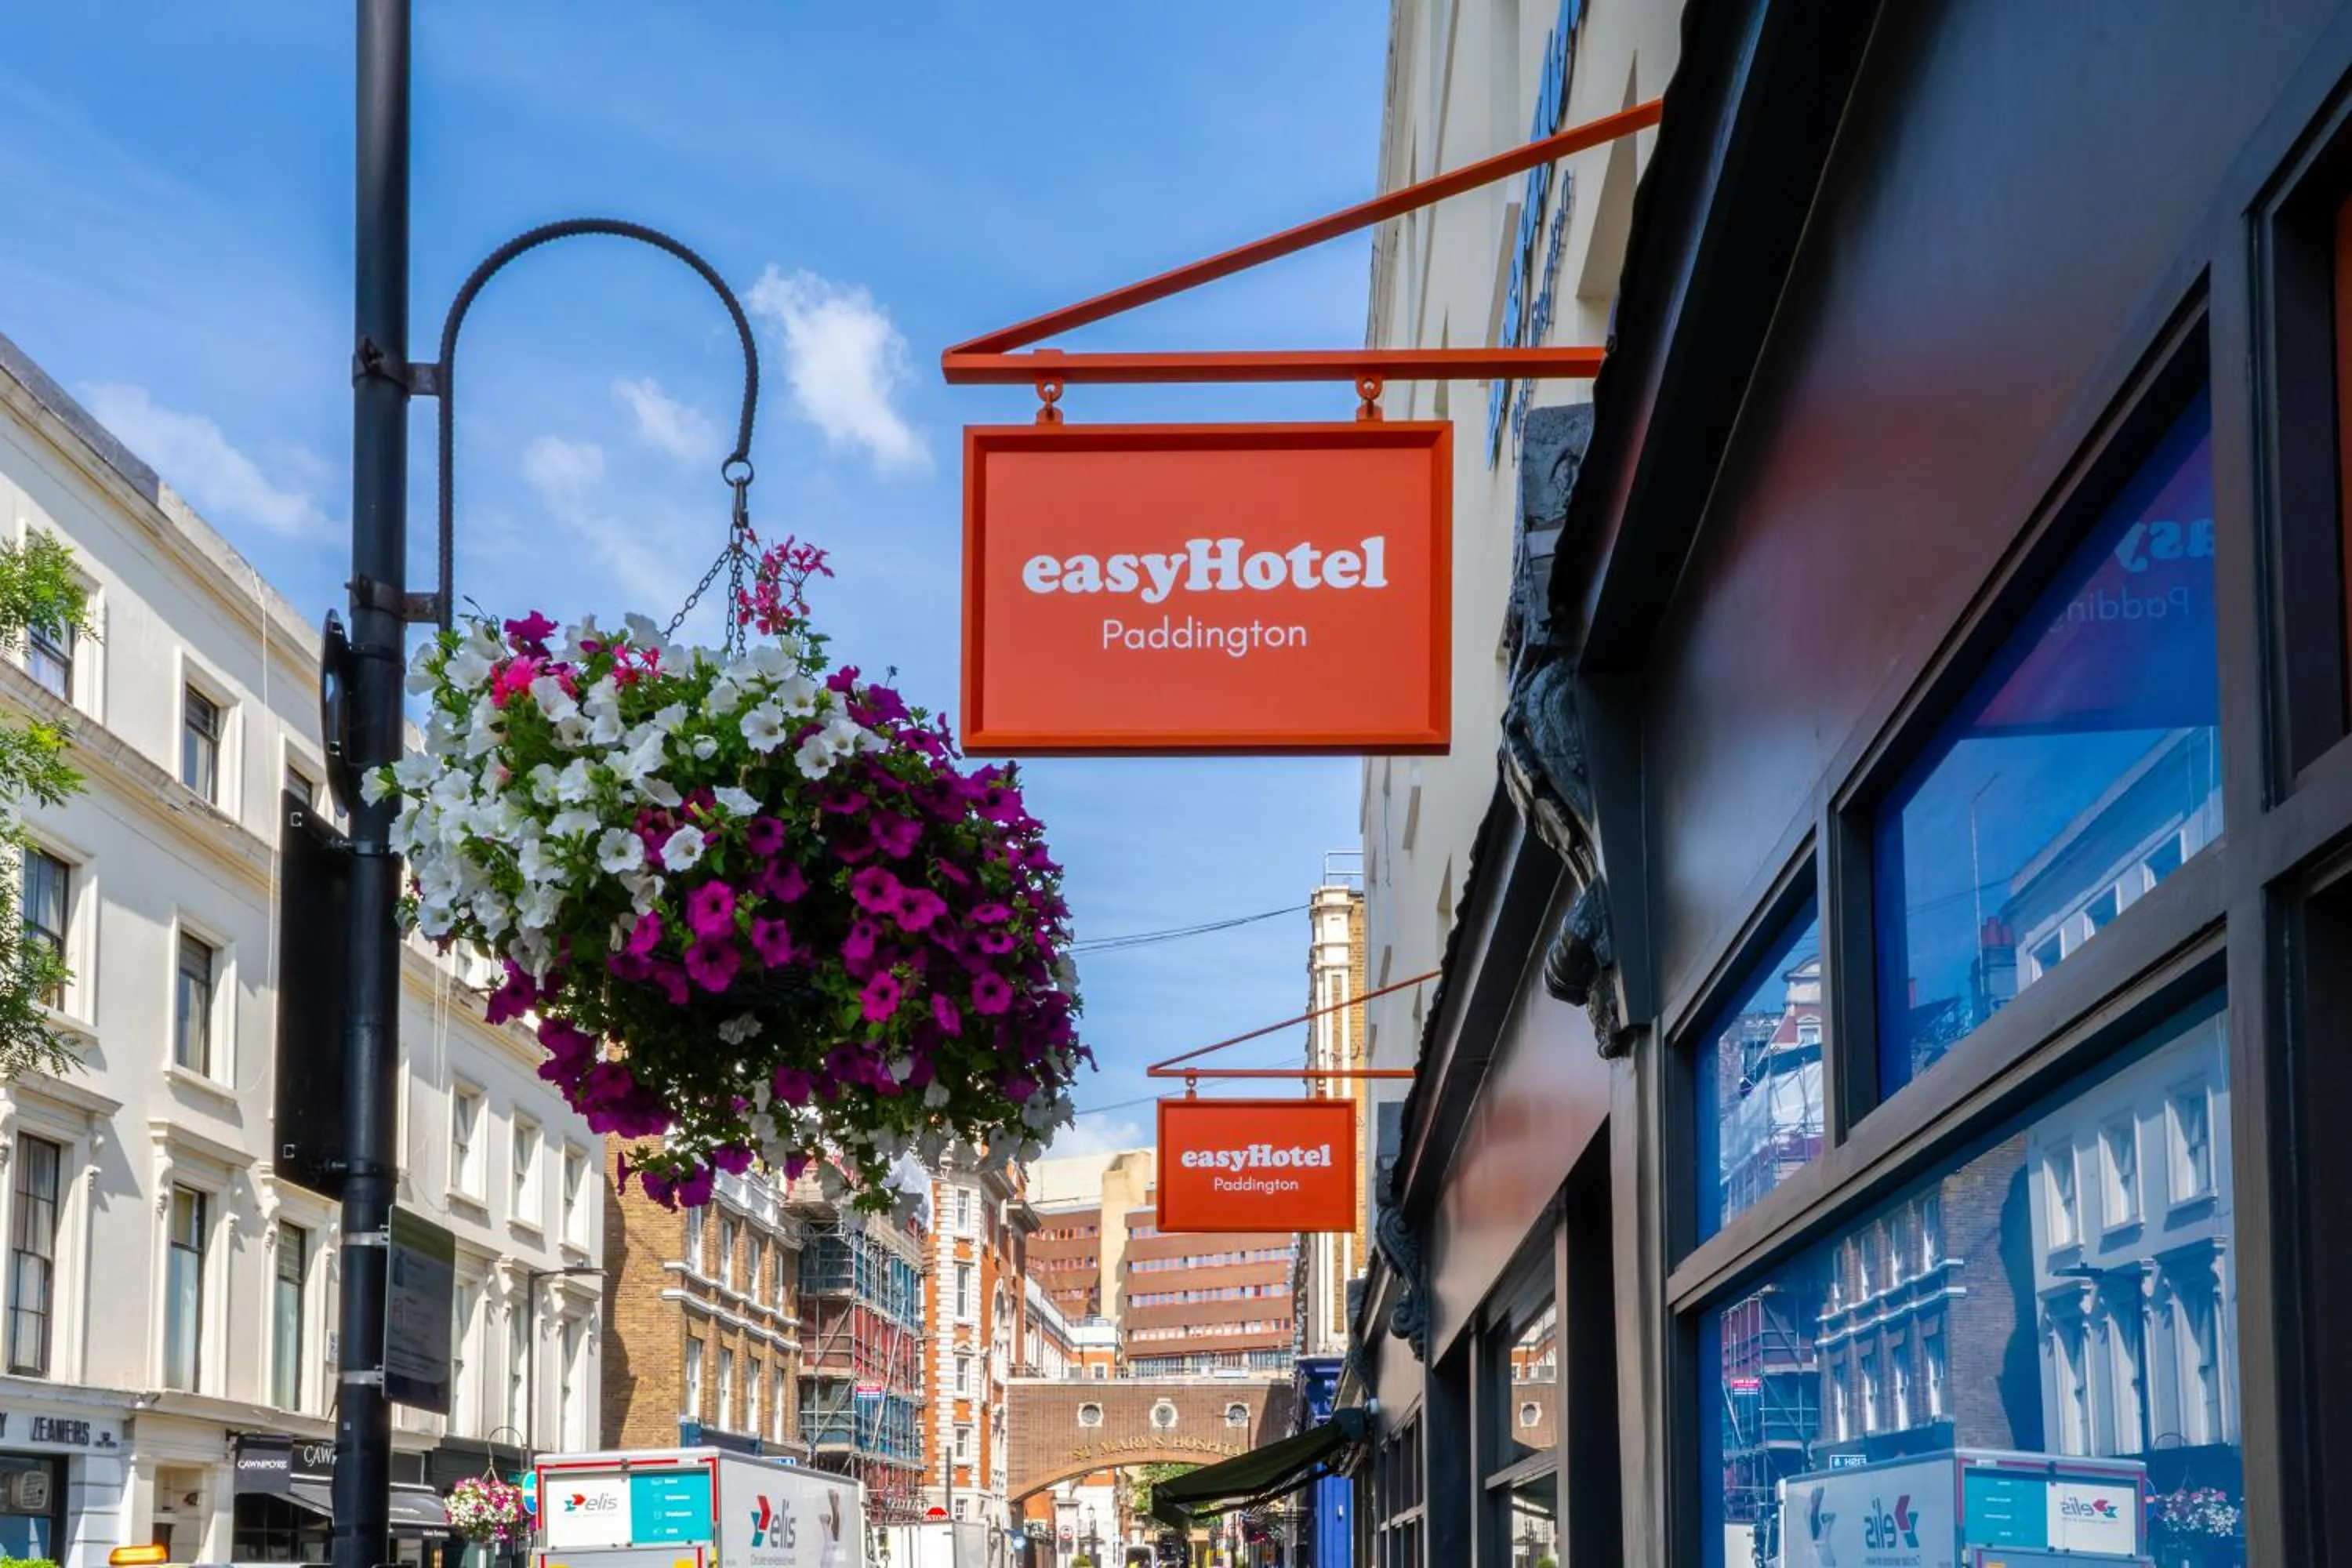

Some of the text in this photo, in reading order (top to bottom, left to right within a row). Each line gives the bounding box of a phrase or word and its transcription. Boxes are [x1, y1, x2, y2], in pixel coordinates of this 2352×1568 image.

[1022, 536, 1388, 604] easyHotel
[1103, 615, 1307, 658] Paddington
[1181, 1144, 1332, 1171] easyHotel
[1214, 1177, 1299, 1194] Paddington
[1173, 1436, 1245, 1456] HOSPITA
[238, 1459, 288, 1469] CAWNPORE
[585, 1493, 618, 1511] elis
[770, 1498, 797, 1549] elis
